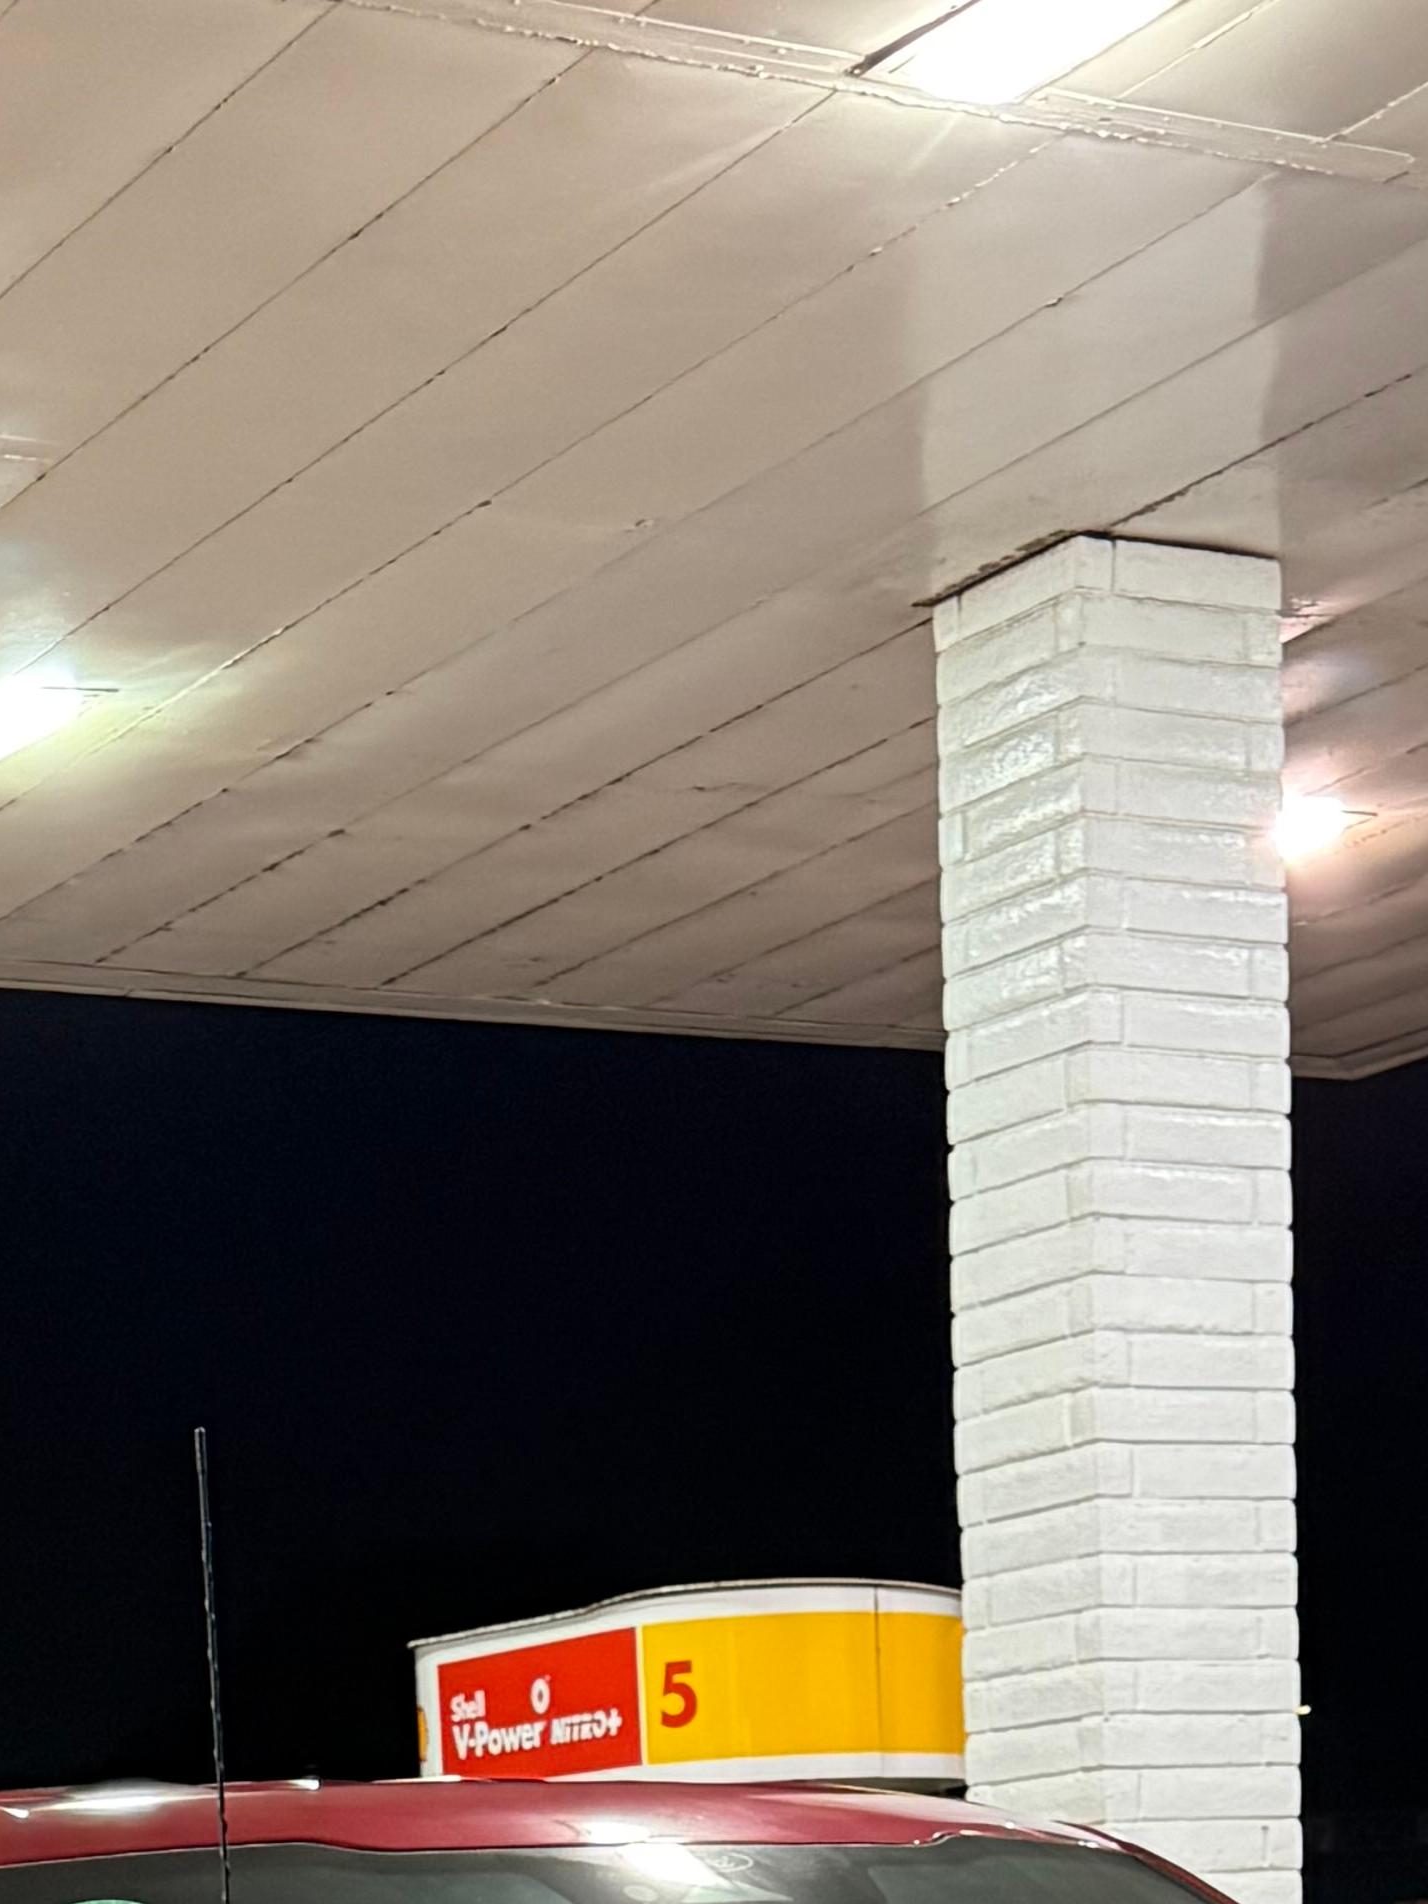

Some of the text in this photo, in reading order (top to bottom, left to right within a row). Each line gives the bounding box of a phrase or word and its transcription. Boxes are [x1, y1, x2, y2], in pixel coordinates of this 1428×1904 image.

[450, 1690, 486, 1722] Shell
[660, 1661, 697, 1728] 5
[452, 1721, 547, 1760] V-Power
